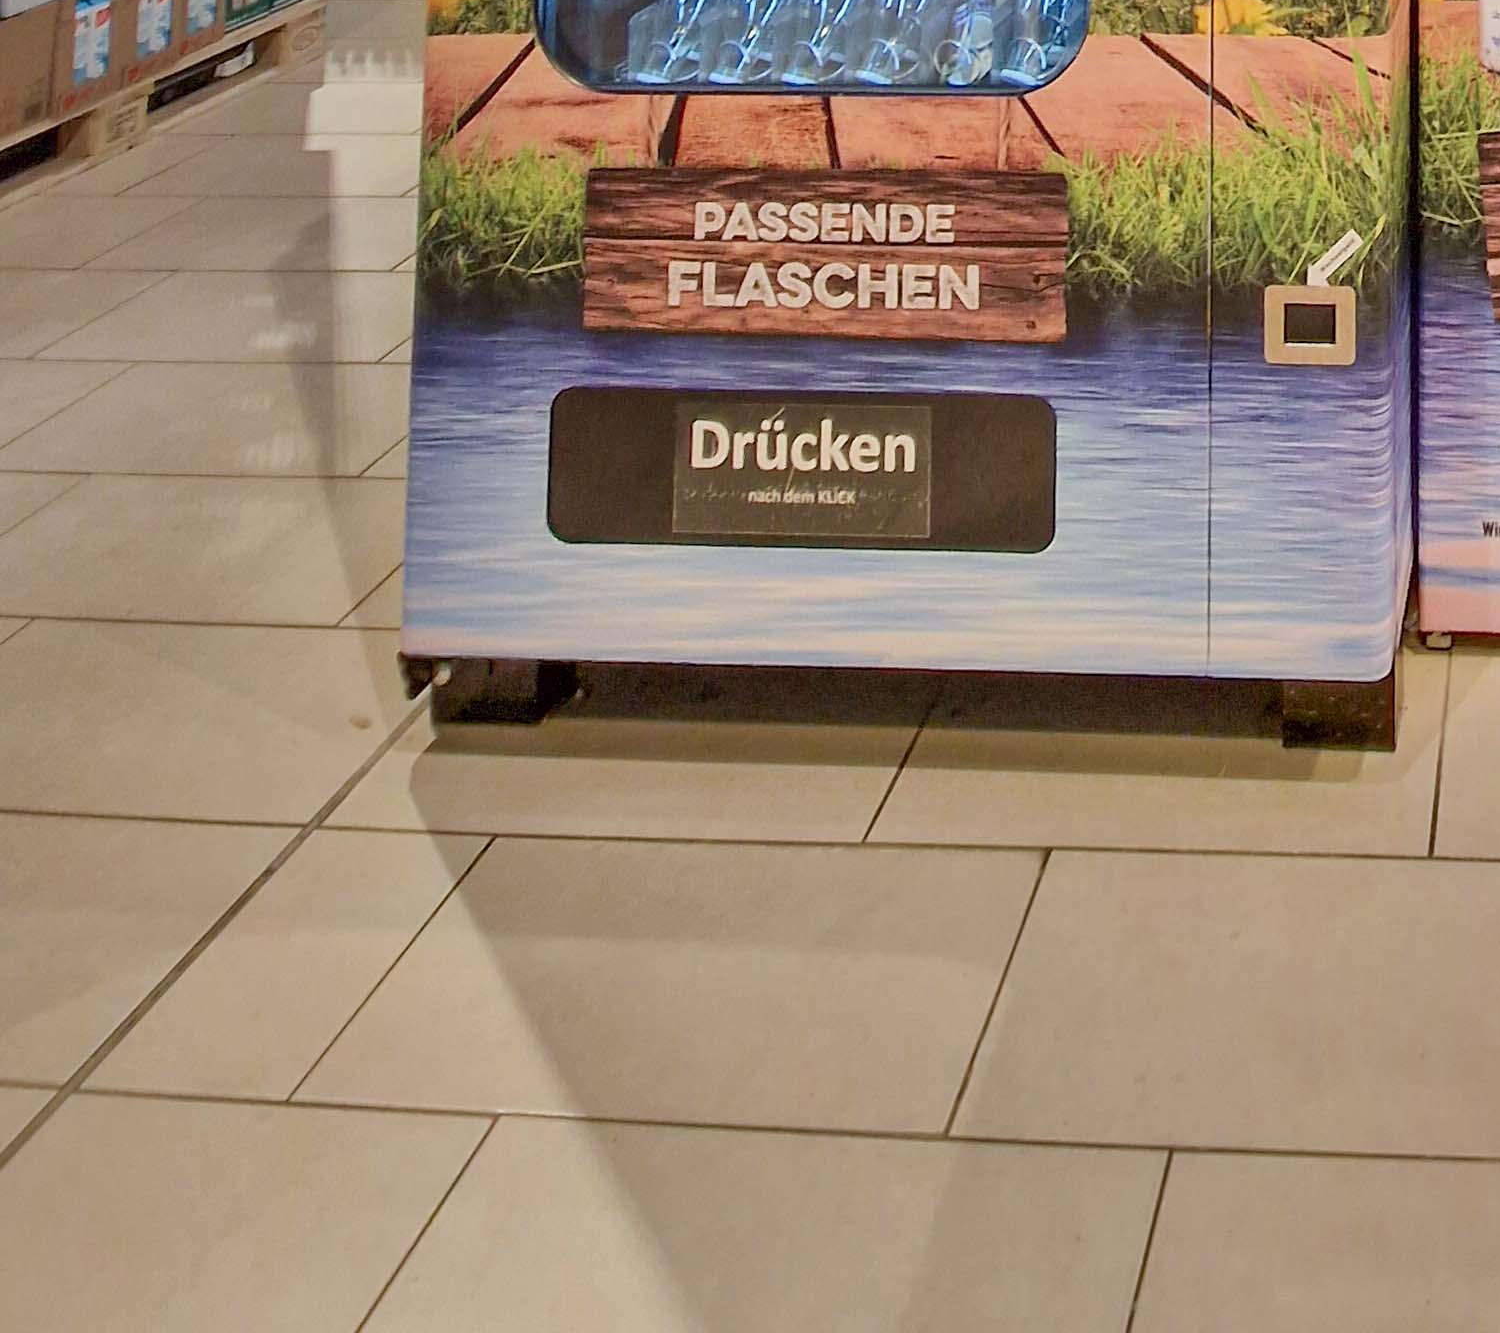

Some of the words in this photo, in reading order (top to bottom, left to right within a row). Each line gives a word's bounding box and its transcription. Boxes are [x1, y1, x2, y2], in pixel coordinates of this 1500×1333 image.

[693, 201, 955, 243] PASSENDE
[668, 260, 980, 310] FLASCHEN
[690, 418, 916, 473] Drücken
[748, 489, 781, 503] nach
[784, 488, 814, 504] dem
[817, 489, 857, 504] KLICK
